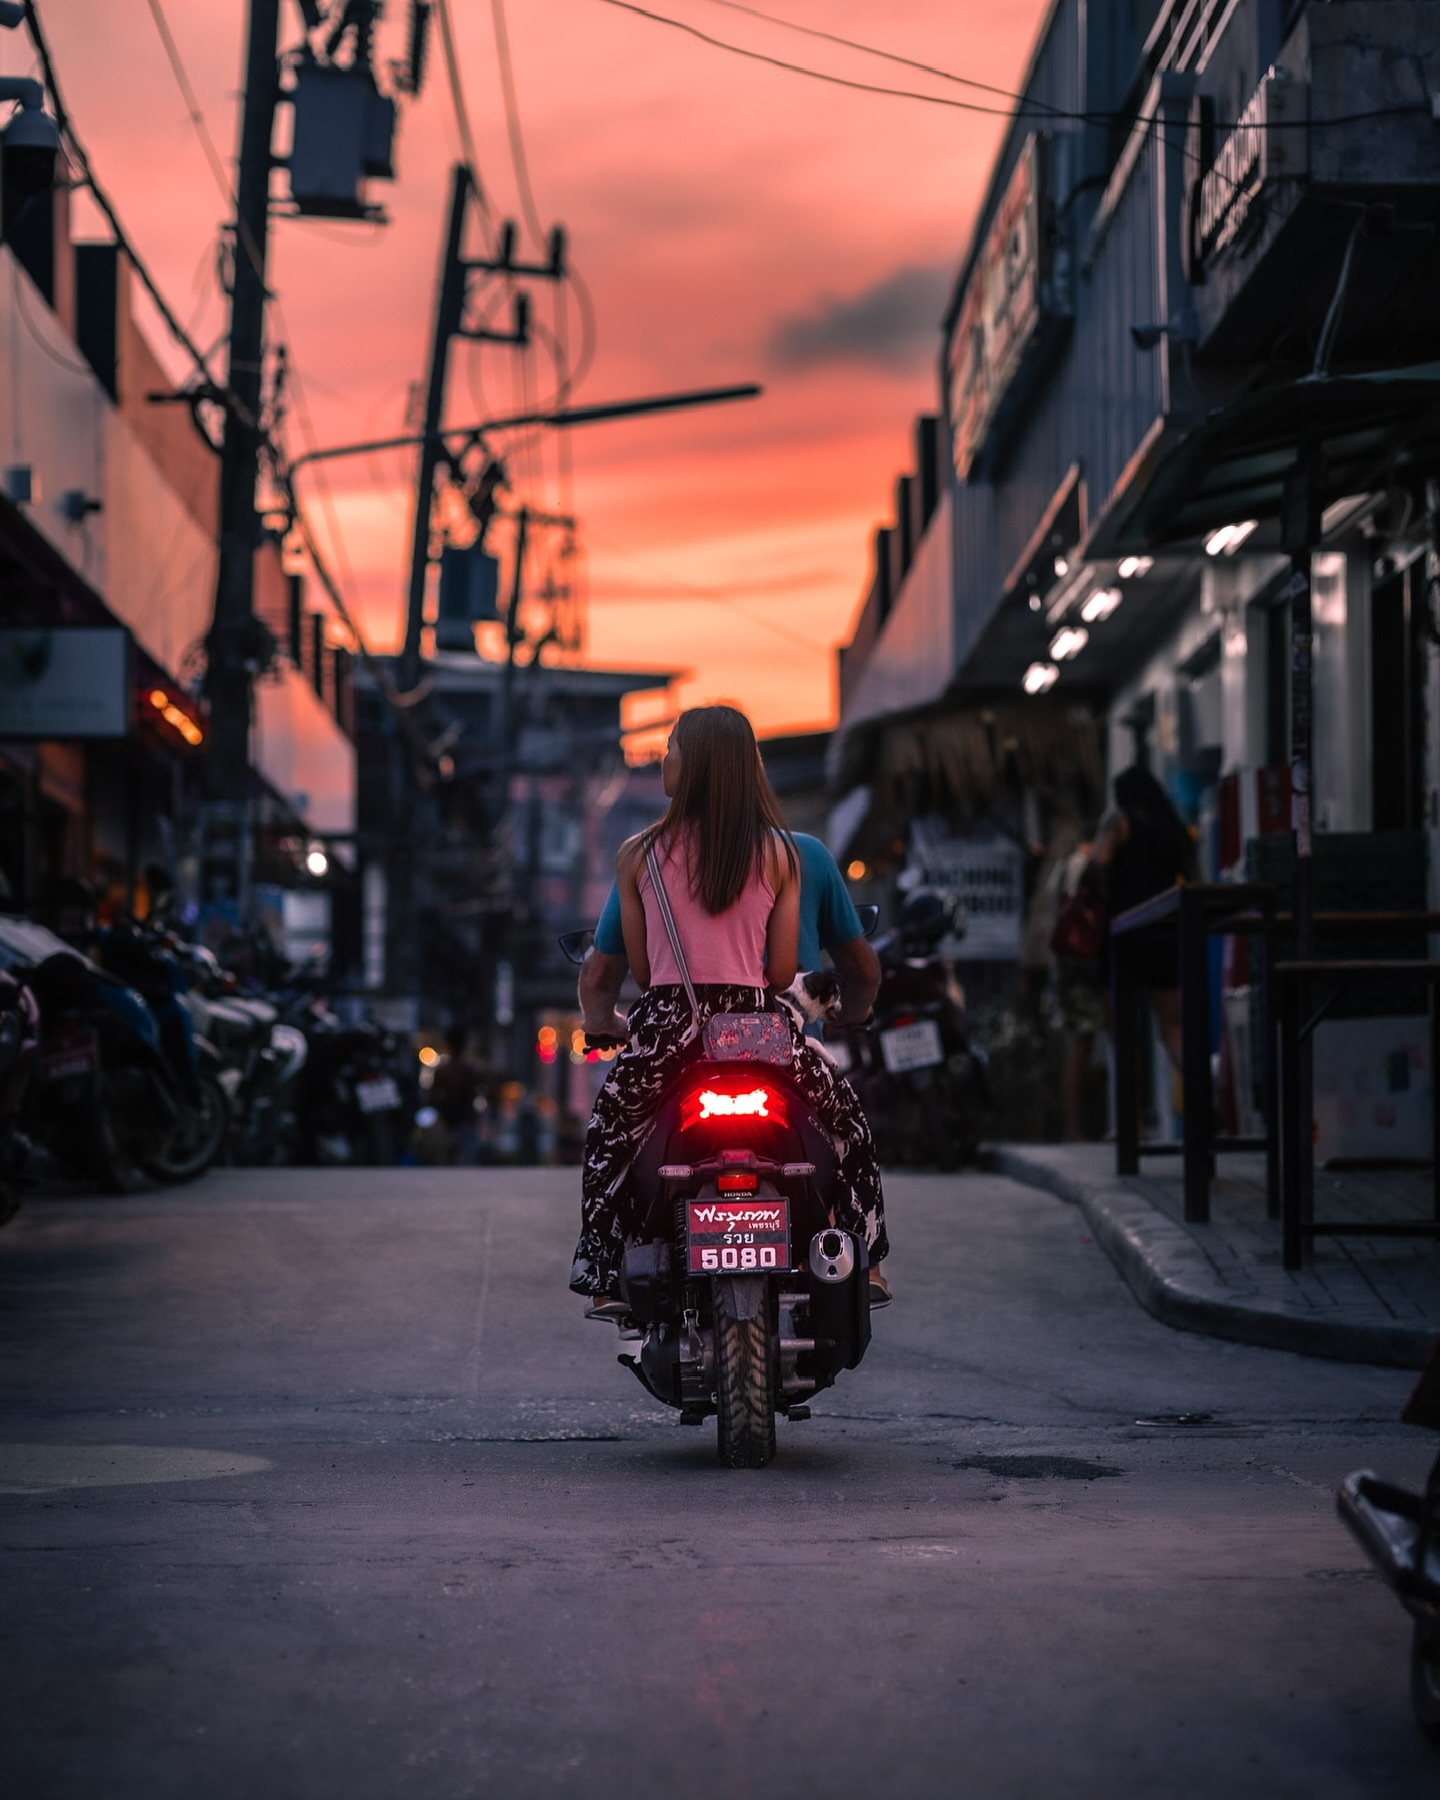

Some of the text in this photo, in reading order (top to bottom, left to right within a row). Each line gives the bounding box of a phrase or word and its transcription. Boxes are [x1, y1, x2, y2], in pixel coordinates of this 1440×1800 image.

[748, 1220, 780, 1231] เพชรบุรี
[723, 1233, 754, 1244] รวย
[701, 1247, 777, 1269] 5080
